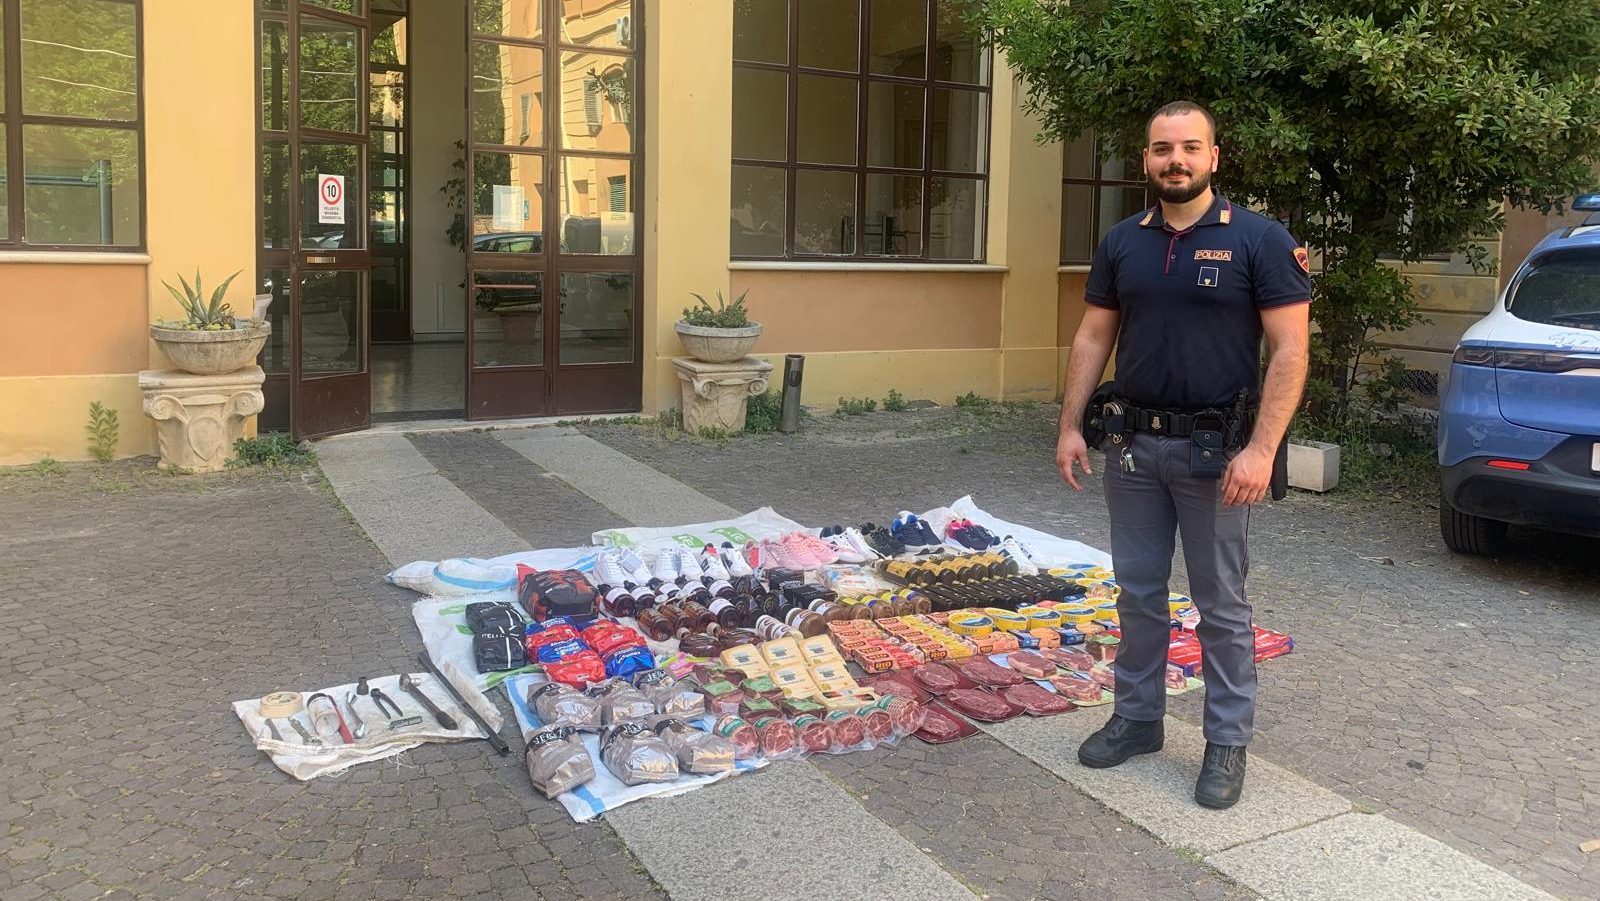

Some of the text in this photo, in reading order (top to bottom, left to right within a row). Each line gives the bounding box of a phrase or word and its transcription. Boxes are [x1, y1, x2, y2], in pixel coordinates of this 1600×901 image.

[326, 185, 336, 197] 10
[1197, 251, 1229, 259] POLIZIA
[875, 661, 892, 669] RIO
